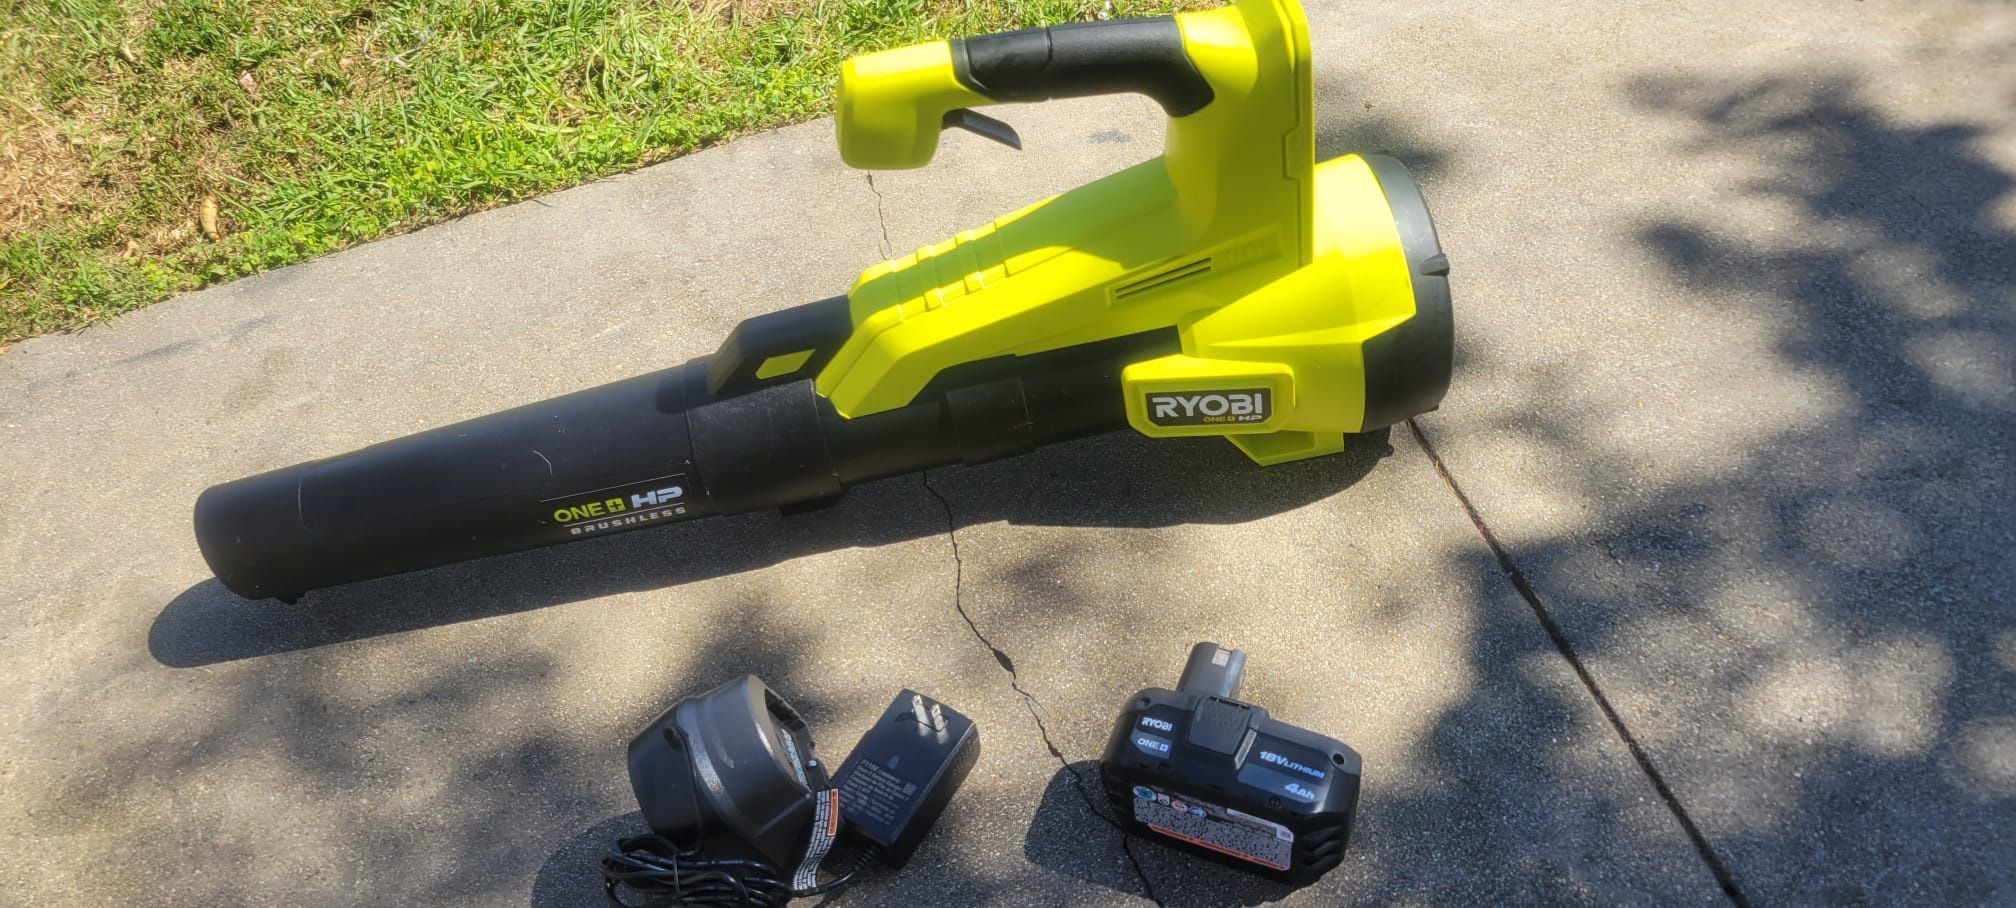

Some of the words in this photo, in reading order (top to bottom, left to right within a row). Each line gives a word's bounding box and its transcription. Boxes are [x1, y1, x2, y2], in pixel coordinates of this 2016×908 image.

[1152, 393, 1263, 418] RYOBI
[631, 486, 683, 509] HP
[570, 507, 686, 535] BRUSHLESS
[1142, 716, 1173, 732] RYOBI
